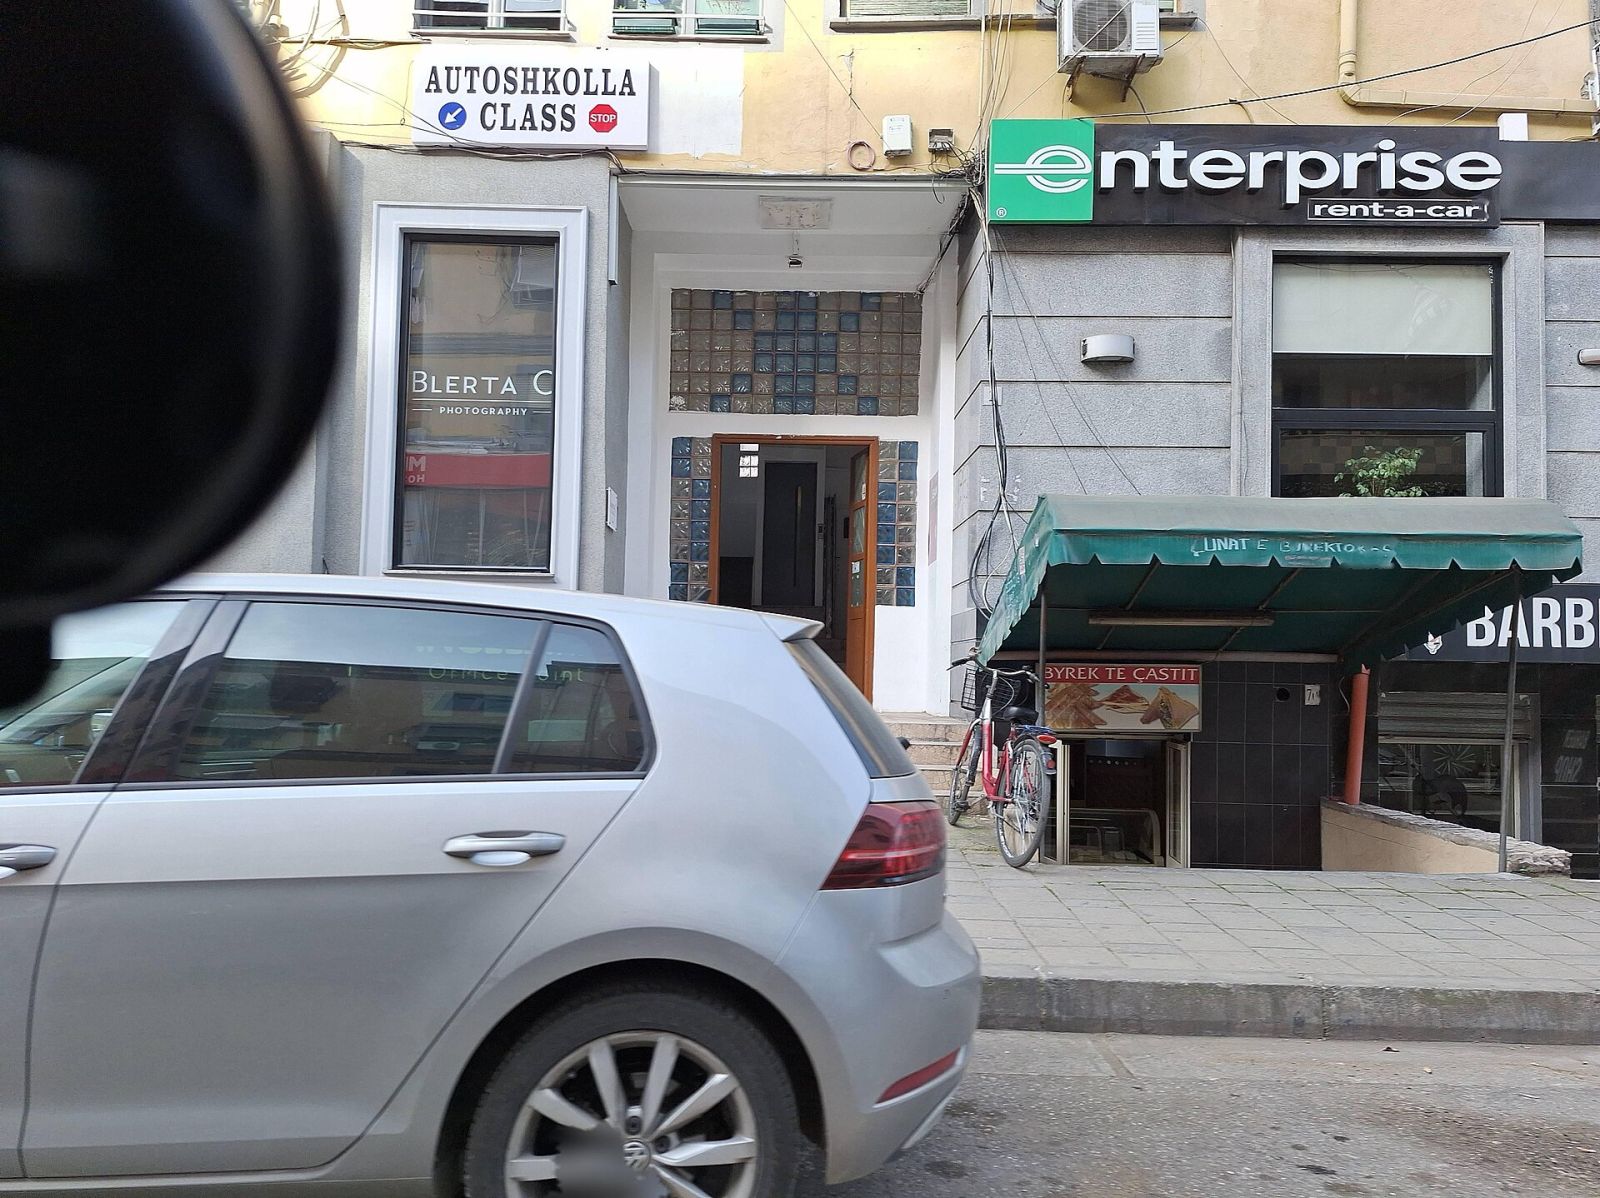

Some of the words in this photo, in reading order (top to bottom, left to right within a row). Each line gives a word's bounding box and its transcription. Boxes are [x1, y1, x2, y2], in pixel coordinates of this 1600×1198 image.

[425, 65, 636, 96] AUTOSHKOLLA
[480, 102, 576, 132] CLASS
[589, 113, 616, 123] STOP
[1314, 200, 1479, 218] rent-a-car
[412, 370, 517, 395] BLERTA
[439, 406, 528, 416] PHOTOGRAPHY
[1466, 597, 1600, 648] BARB
[1045, 667, 1100, 680] BYREK
[1105, 667, 1126, 680] TE
